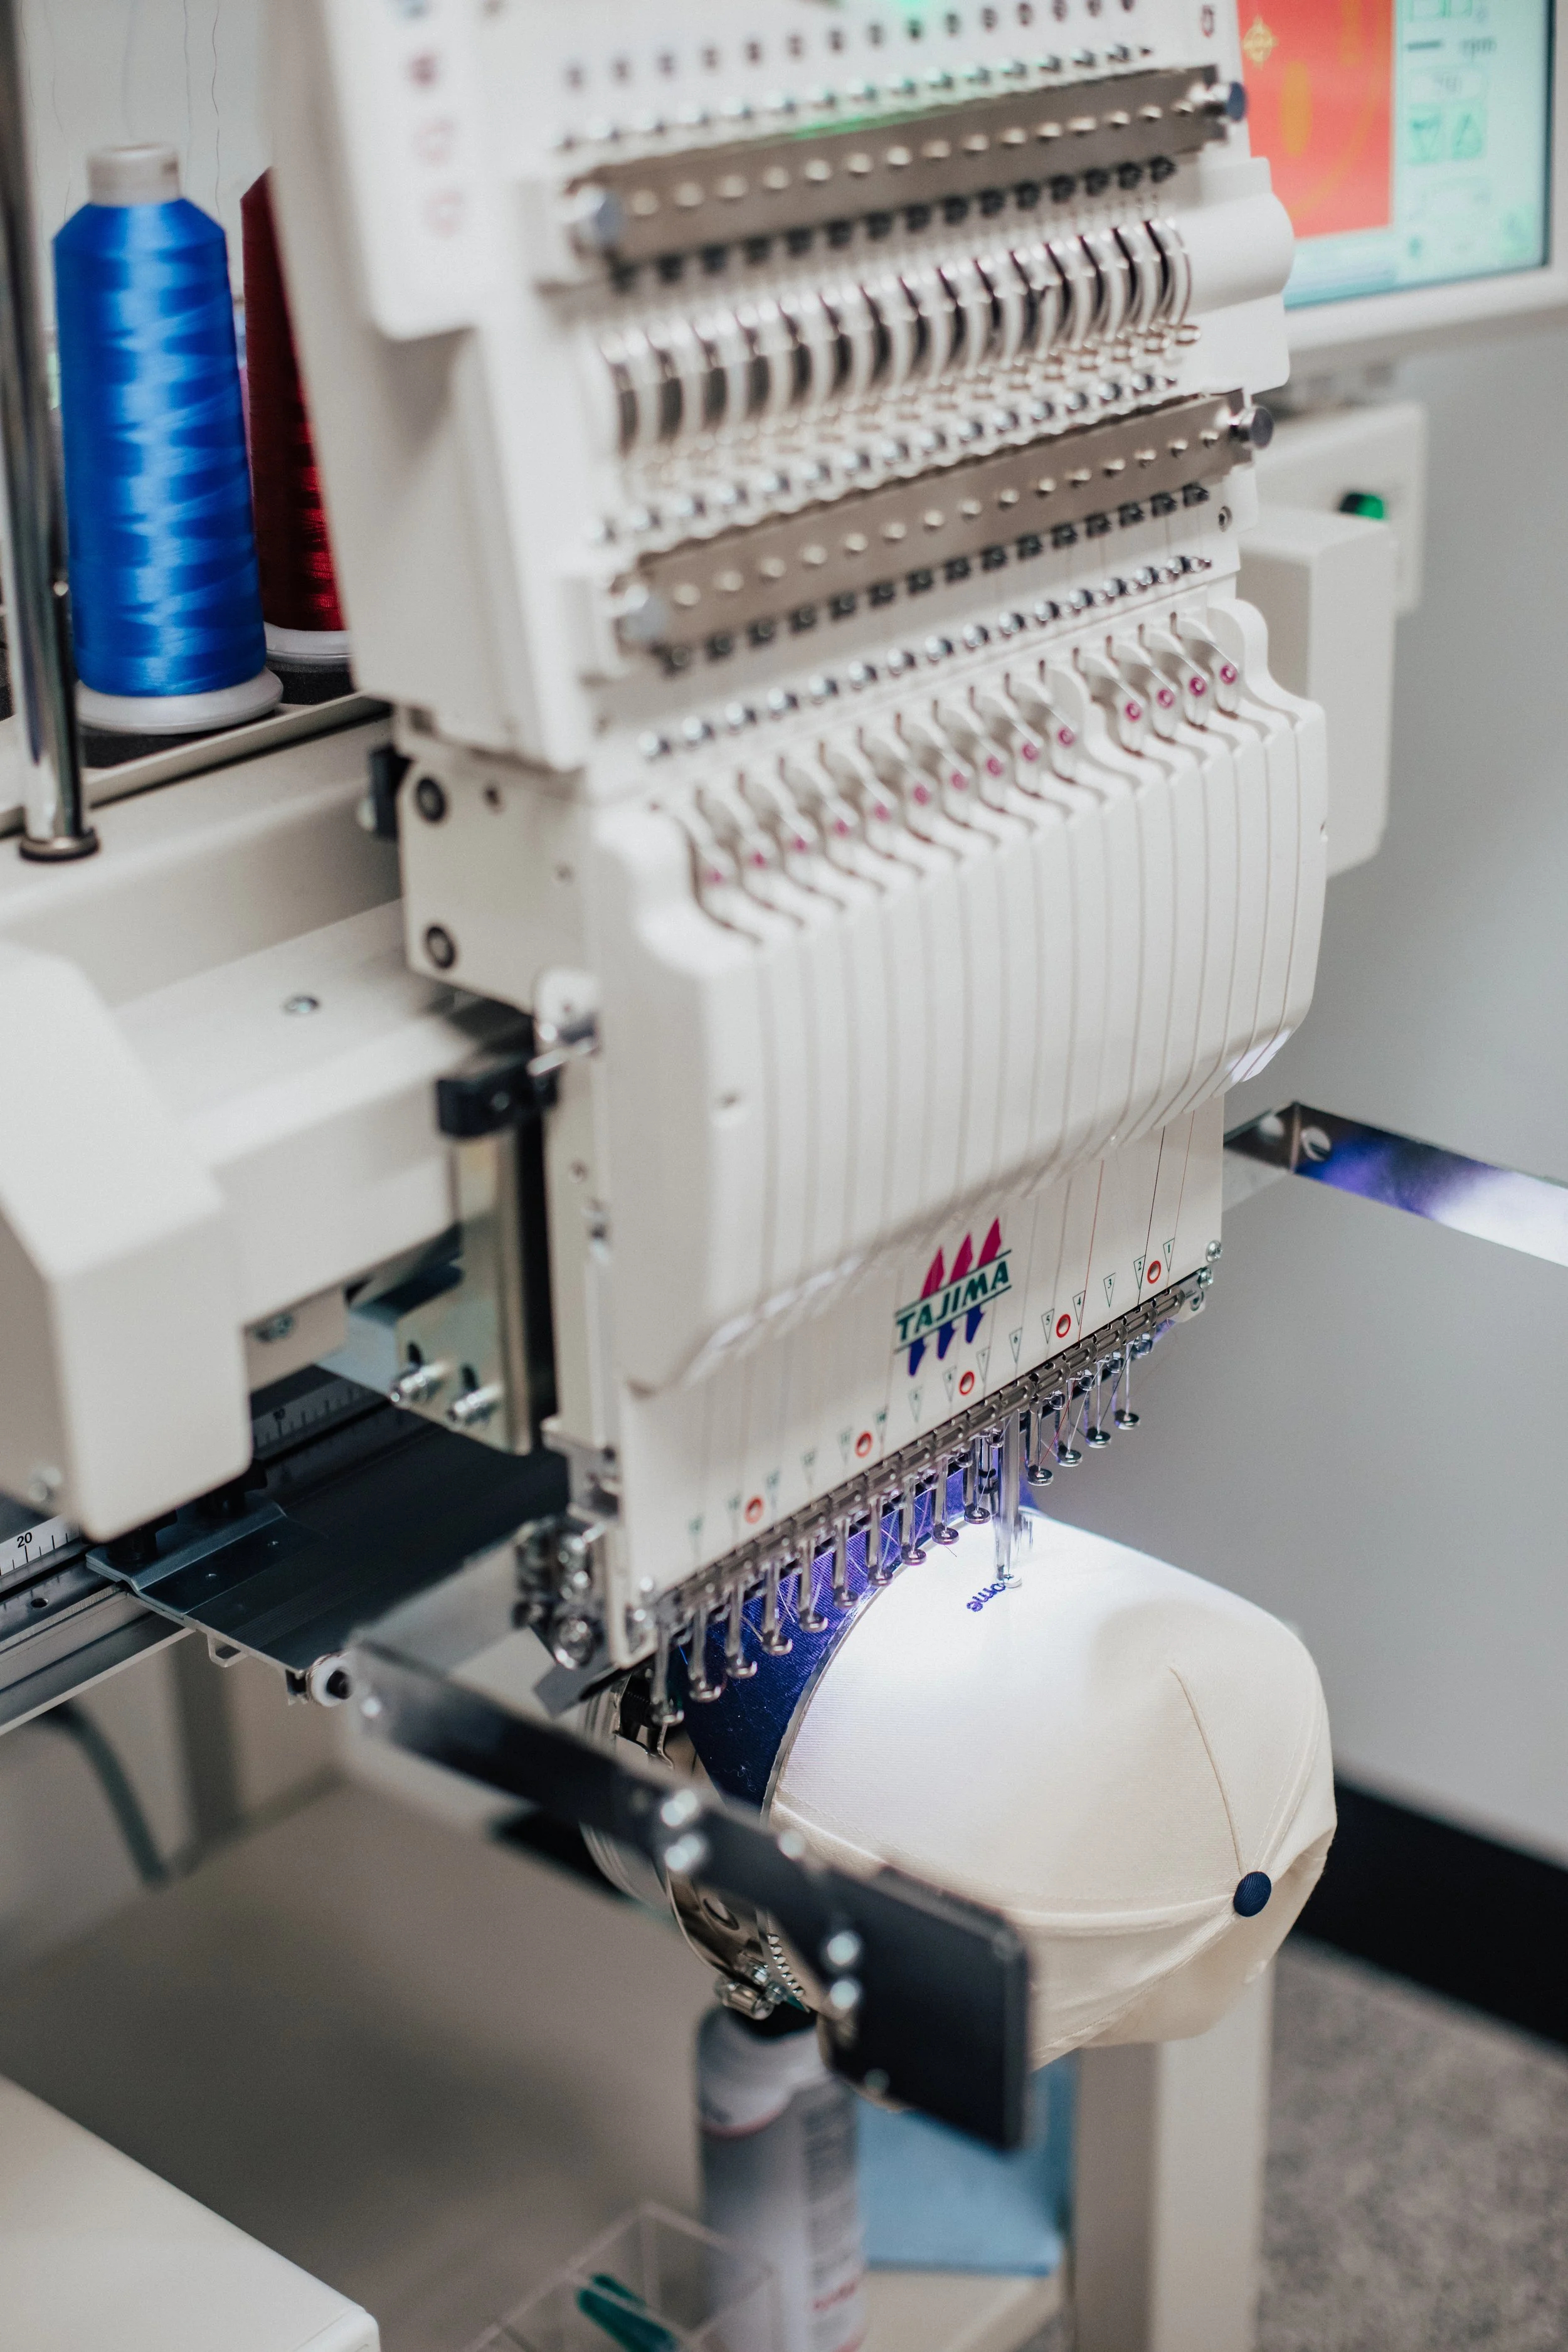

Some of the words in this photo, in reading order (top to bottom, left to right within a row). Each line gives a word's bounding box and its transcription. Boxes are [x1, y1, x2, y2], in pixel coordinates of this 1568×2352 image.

[1167, 1244, 1171, 1253] 1
[1138, 1261, 1142, 1271] 2
[1107, 1278, 1112, 1288] 3
[896, 1260, 1009, 1340] TAJIMA
[1076, 1296, 1081, 1306] 4
[1046, 1315, 1050, 1325] 5
[16, 1532, 33, 1549] 20
